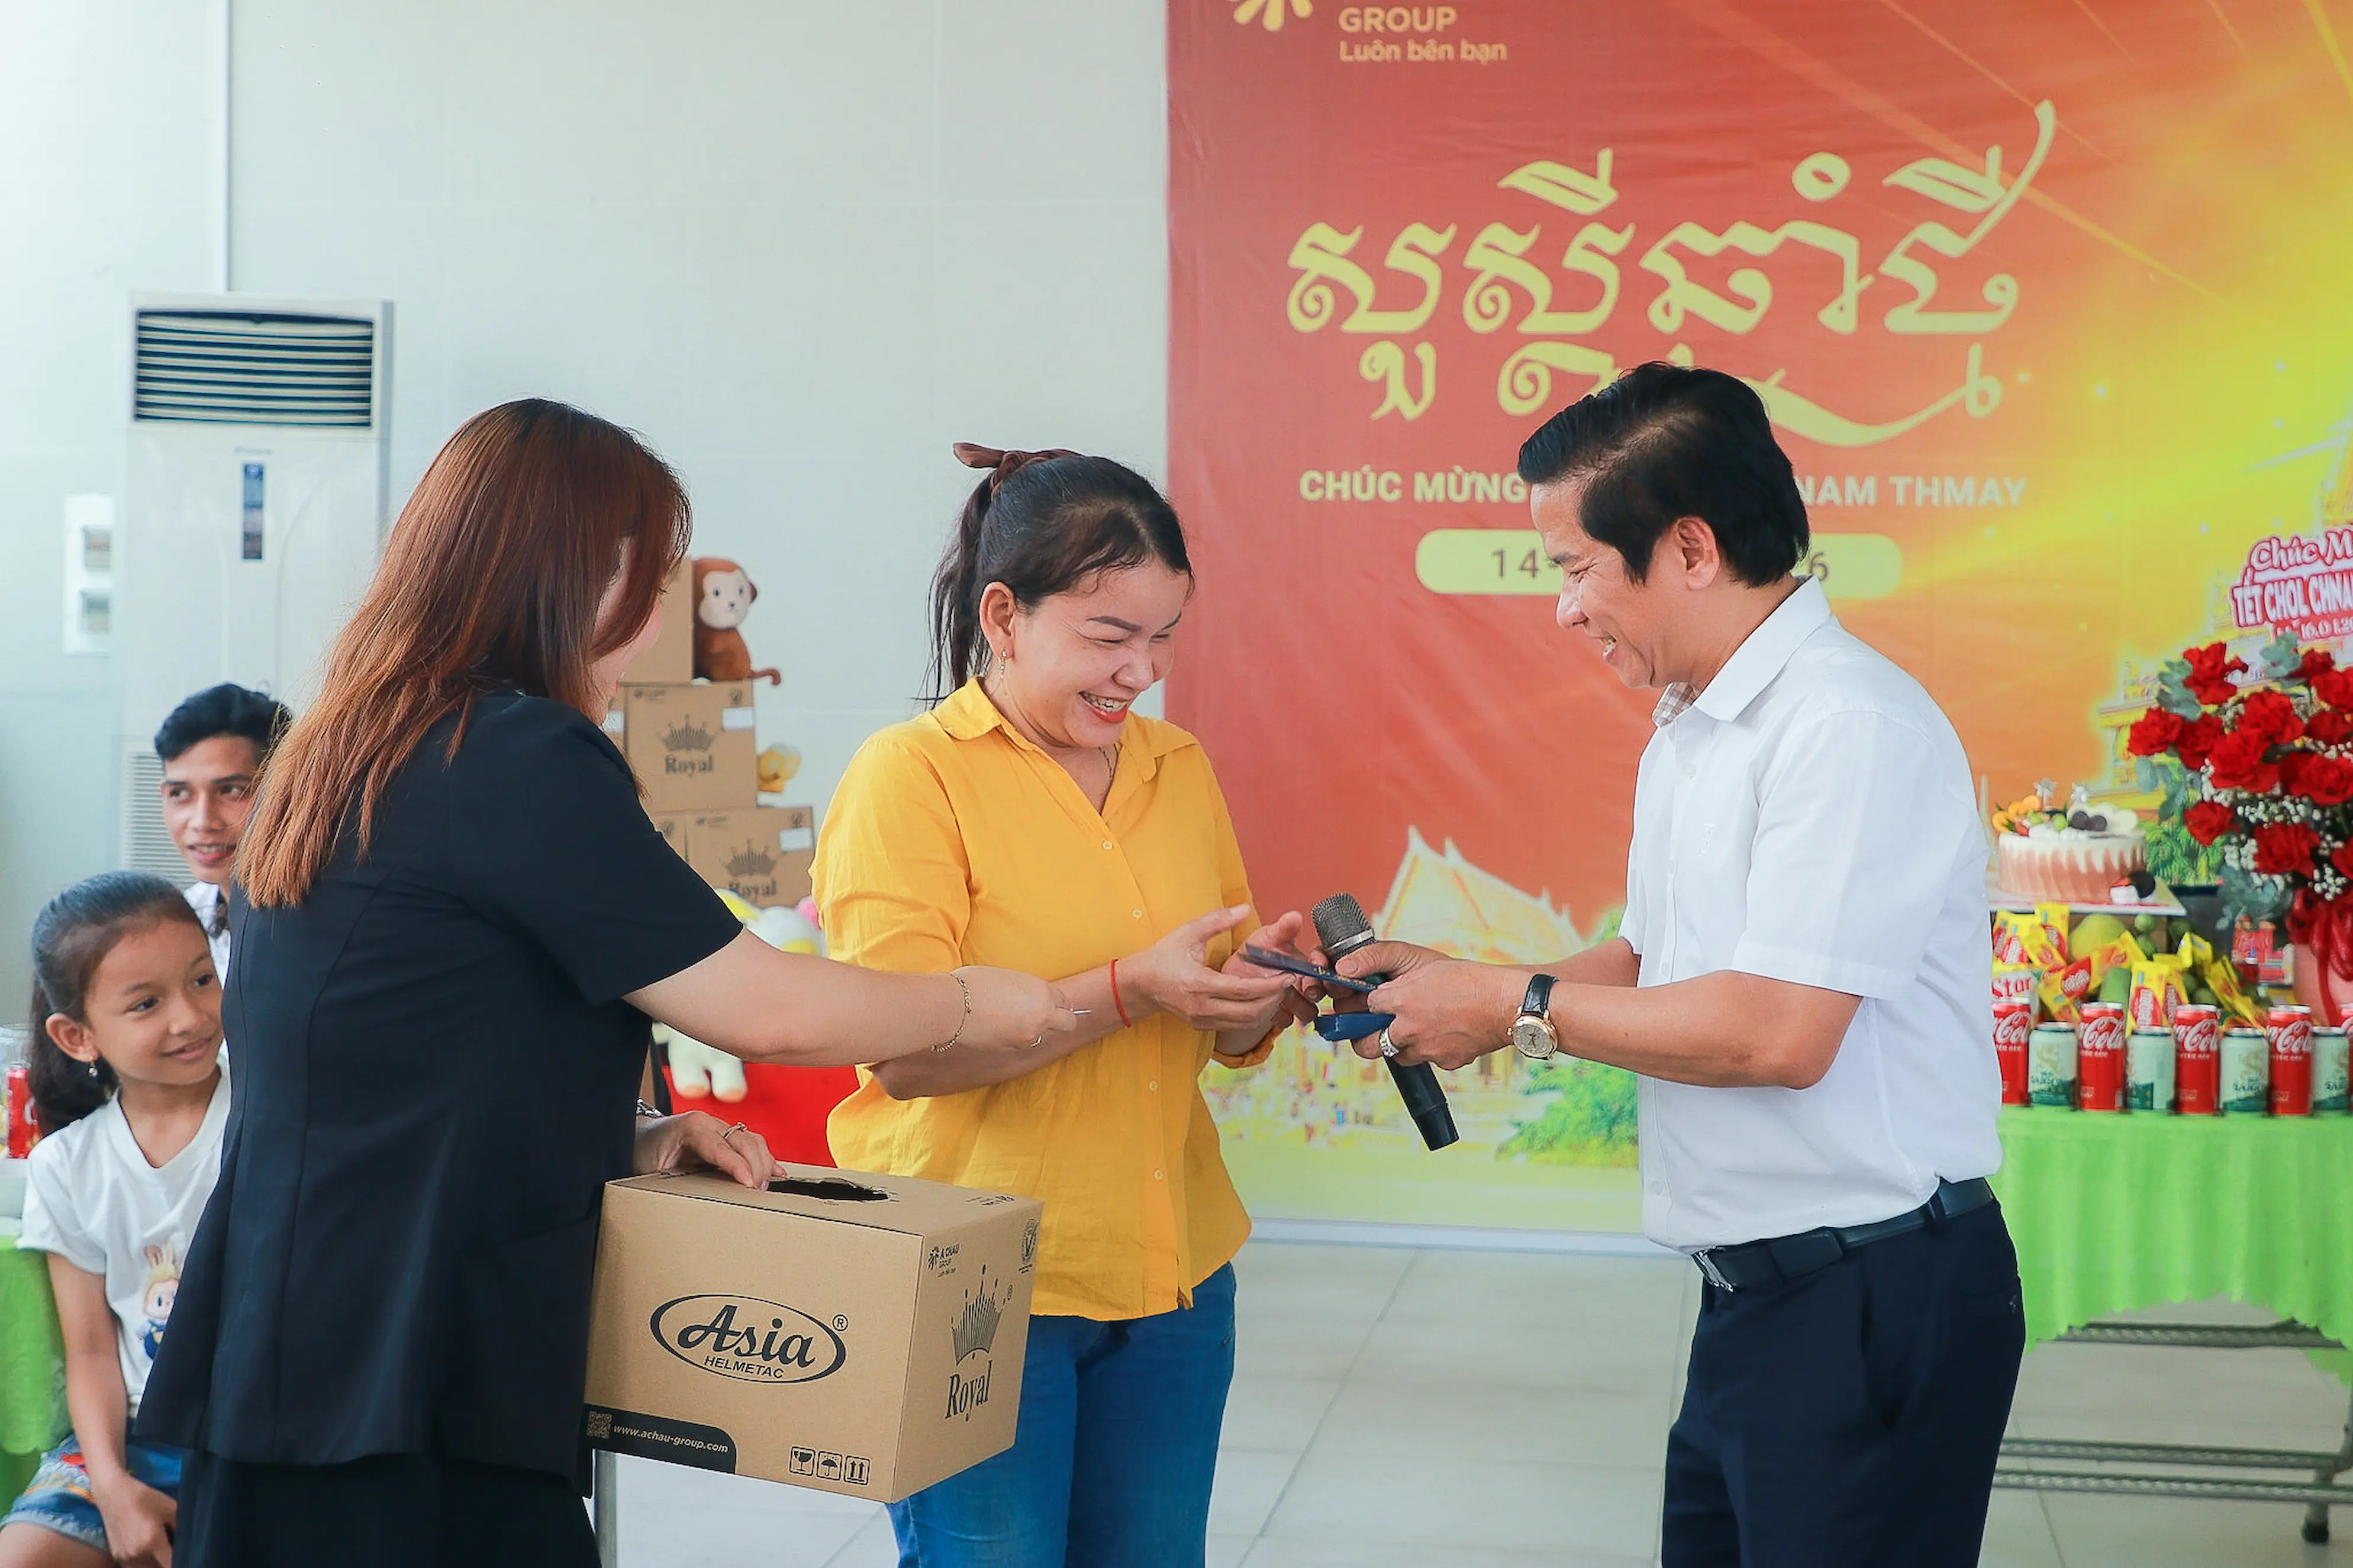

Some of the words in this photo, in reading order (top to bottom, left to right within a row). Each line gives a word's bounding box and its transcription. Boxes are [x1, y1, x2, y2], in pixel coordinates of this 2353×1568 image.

[1339, 6, 1458, 33] GROUP
[1339, 39, 1401, 62] Luôn
[1407, 38, 1454, 62] bên
[1460, 38, 1507, 65] bạn
[1300, 464, 1403, 502] CHÚC
[1413, 464, 1528, 504] MỪNG
[1888, 475, 2029, 507] THMAY
[1491, 549, 1540, 579] 14
[2249, 534, 2319, 571] Chúc
[2264, 577, 2309, 623] CHOL
[2308, 571, 2353, 615] CHNA
[665, 754, 714, 779] Royal
[678, 1305, 816, 1367] Asia
[704, 1356, 784, 1379] HELMETAC
[945, 1360, 993, 1420] Royal
[613, 1424, 729, 1454] www.achau-group.com
